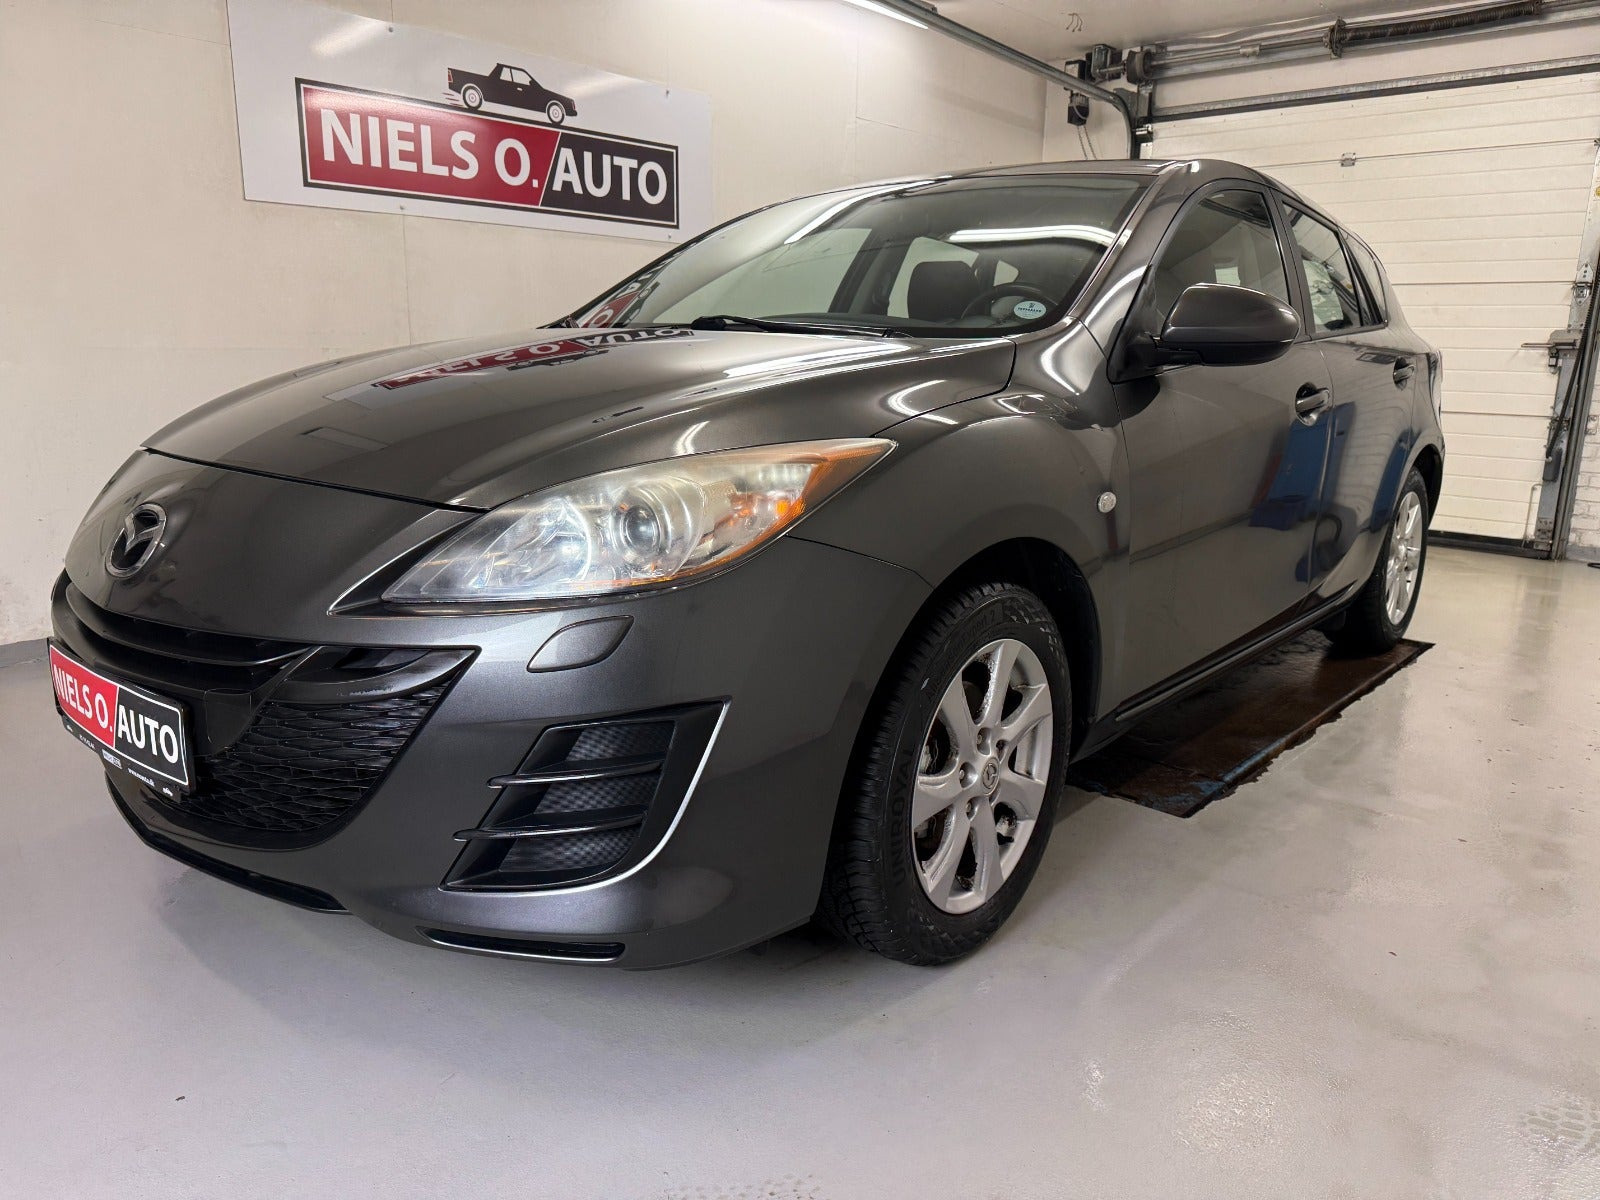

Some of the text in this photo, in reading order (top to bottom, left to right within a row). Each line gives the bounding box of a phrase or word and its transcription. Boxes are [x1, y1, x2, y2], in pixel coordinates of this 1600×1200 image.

[320, 108, 668, 205] NIELS O. AUTO
[53, 664, 179, 764] NIELS O. AUTO
[890, 743, 915, 888] UNIROYAL
